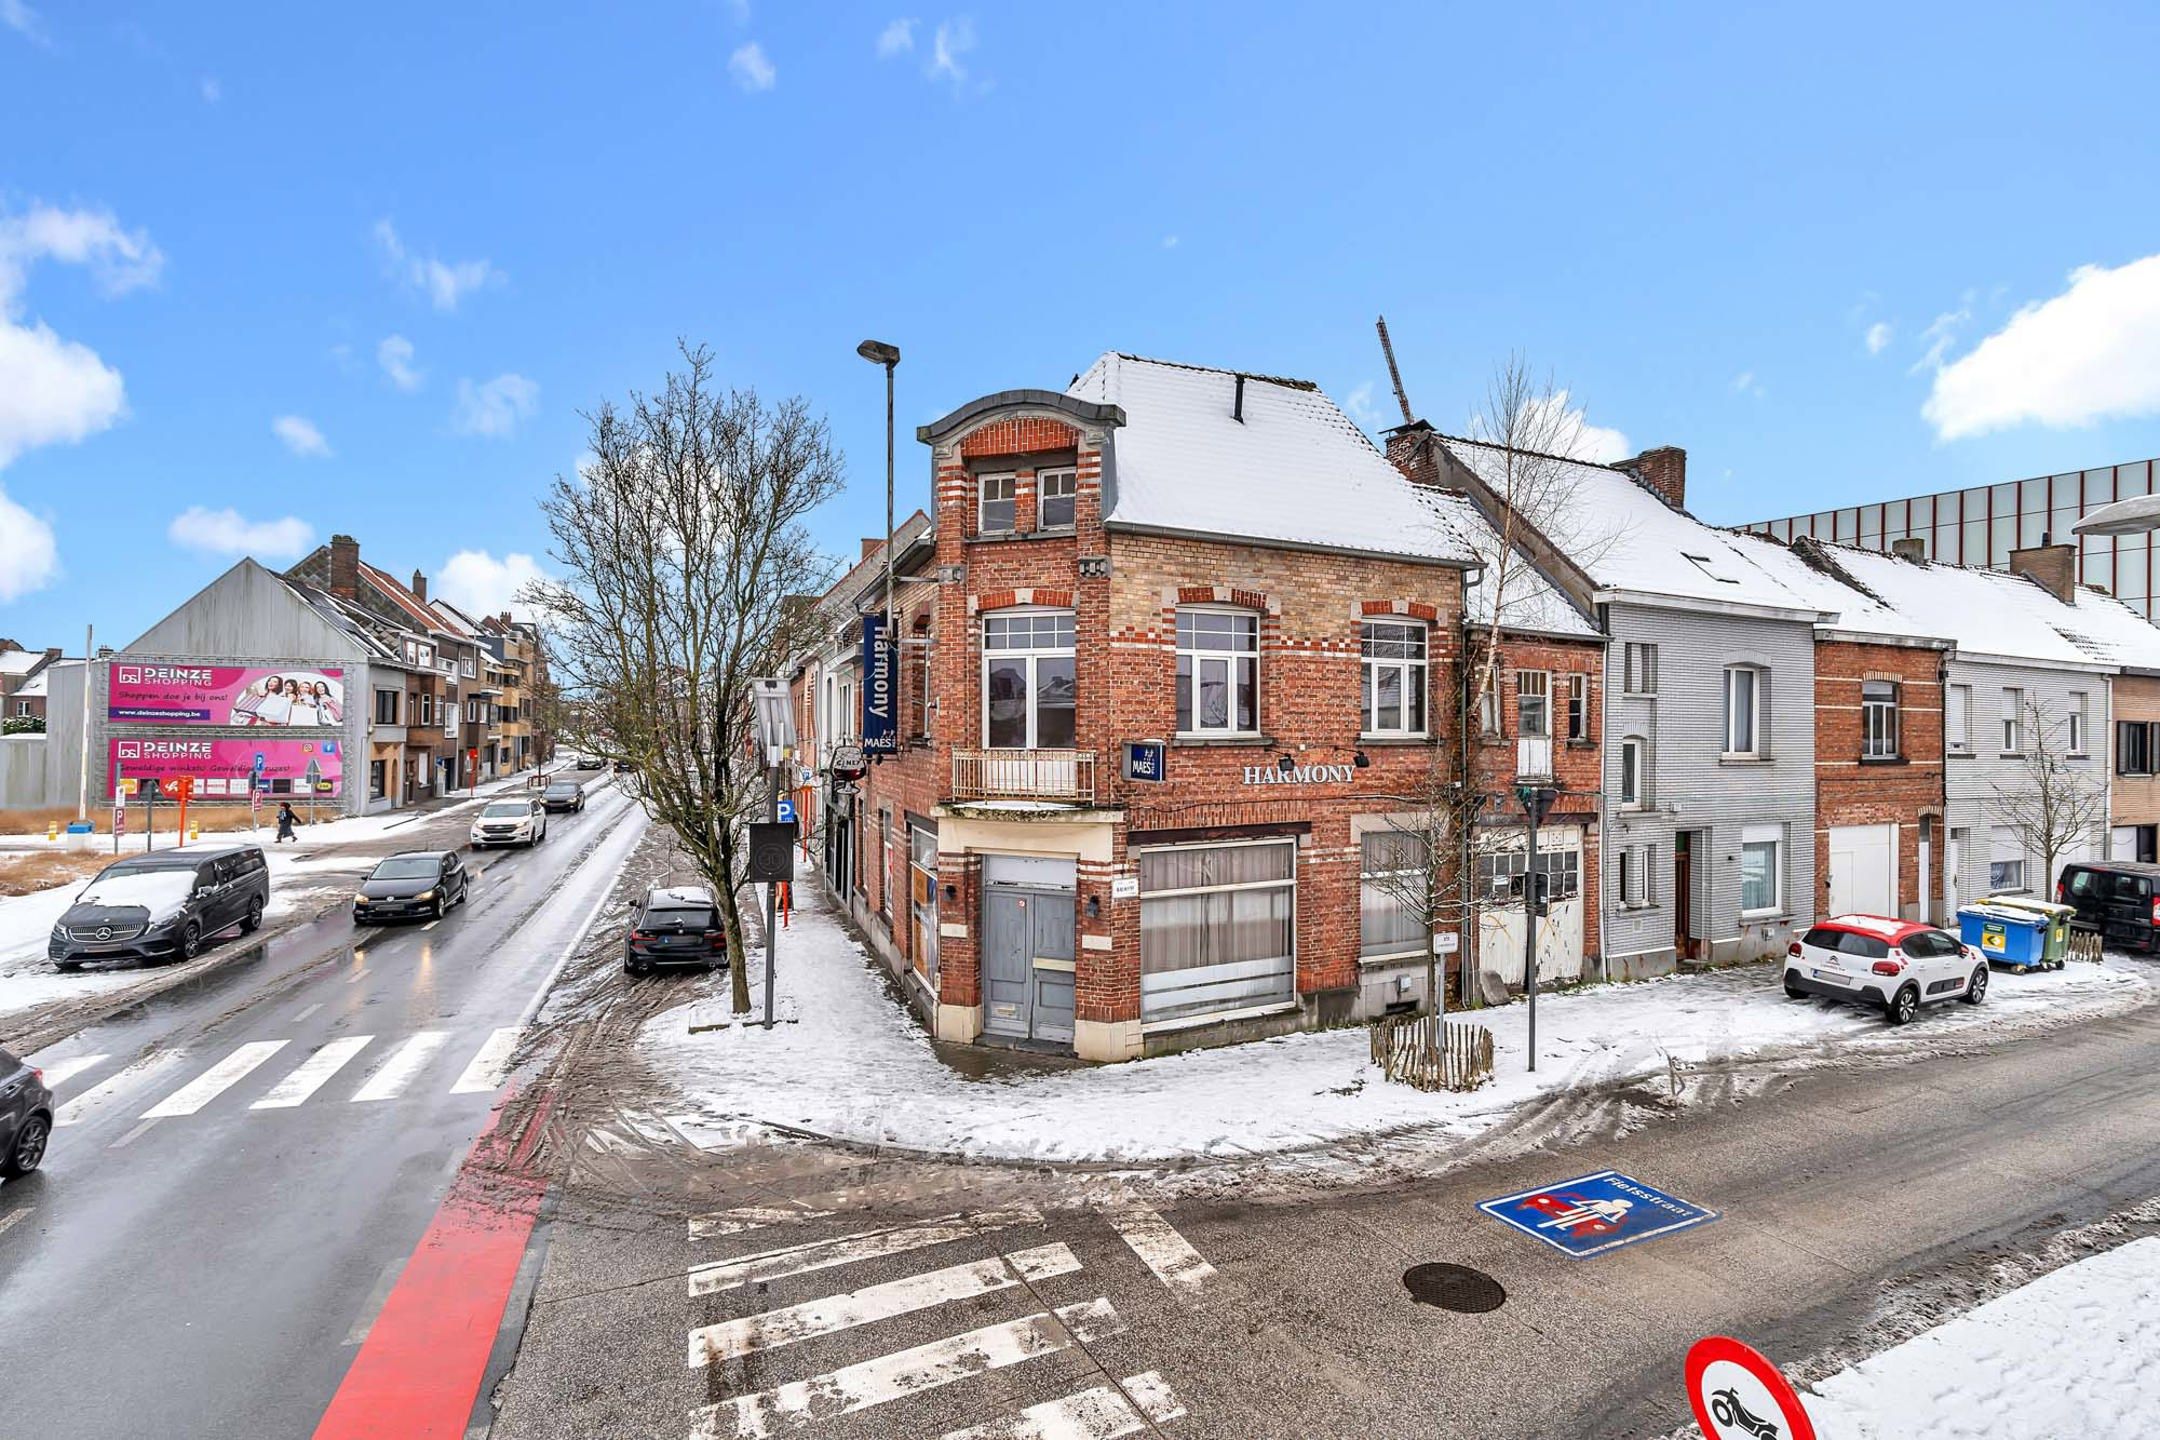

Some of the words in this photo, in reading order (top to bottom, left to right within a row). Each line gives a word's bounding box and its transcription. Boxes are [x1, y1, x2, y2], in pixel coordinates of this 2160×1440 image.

[144, 668, 212, 680] DEINZE
[869, 625, 890, 719] Harmony
[144, 678, 213, 687] SHOPPING
[118, 691, 160, 702] Shoppen
[182, 692, 191, 703] je
[195, 692, 206, 702] bij
[118, 710, 201, 718] www.deinzeshopping.be
[143, 742, 212, 753] DEINZE
[864, 738, 891, 748] MAES
[143, 752, 212, 760] SHOPPING
[1132, 760, 1151, 774] MAES
[1243, 765, 1356, 784] HARMONY
[778, 803, 791, 822] P
[1603, 1177, 1694, 1216] Fietsstraat
